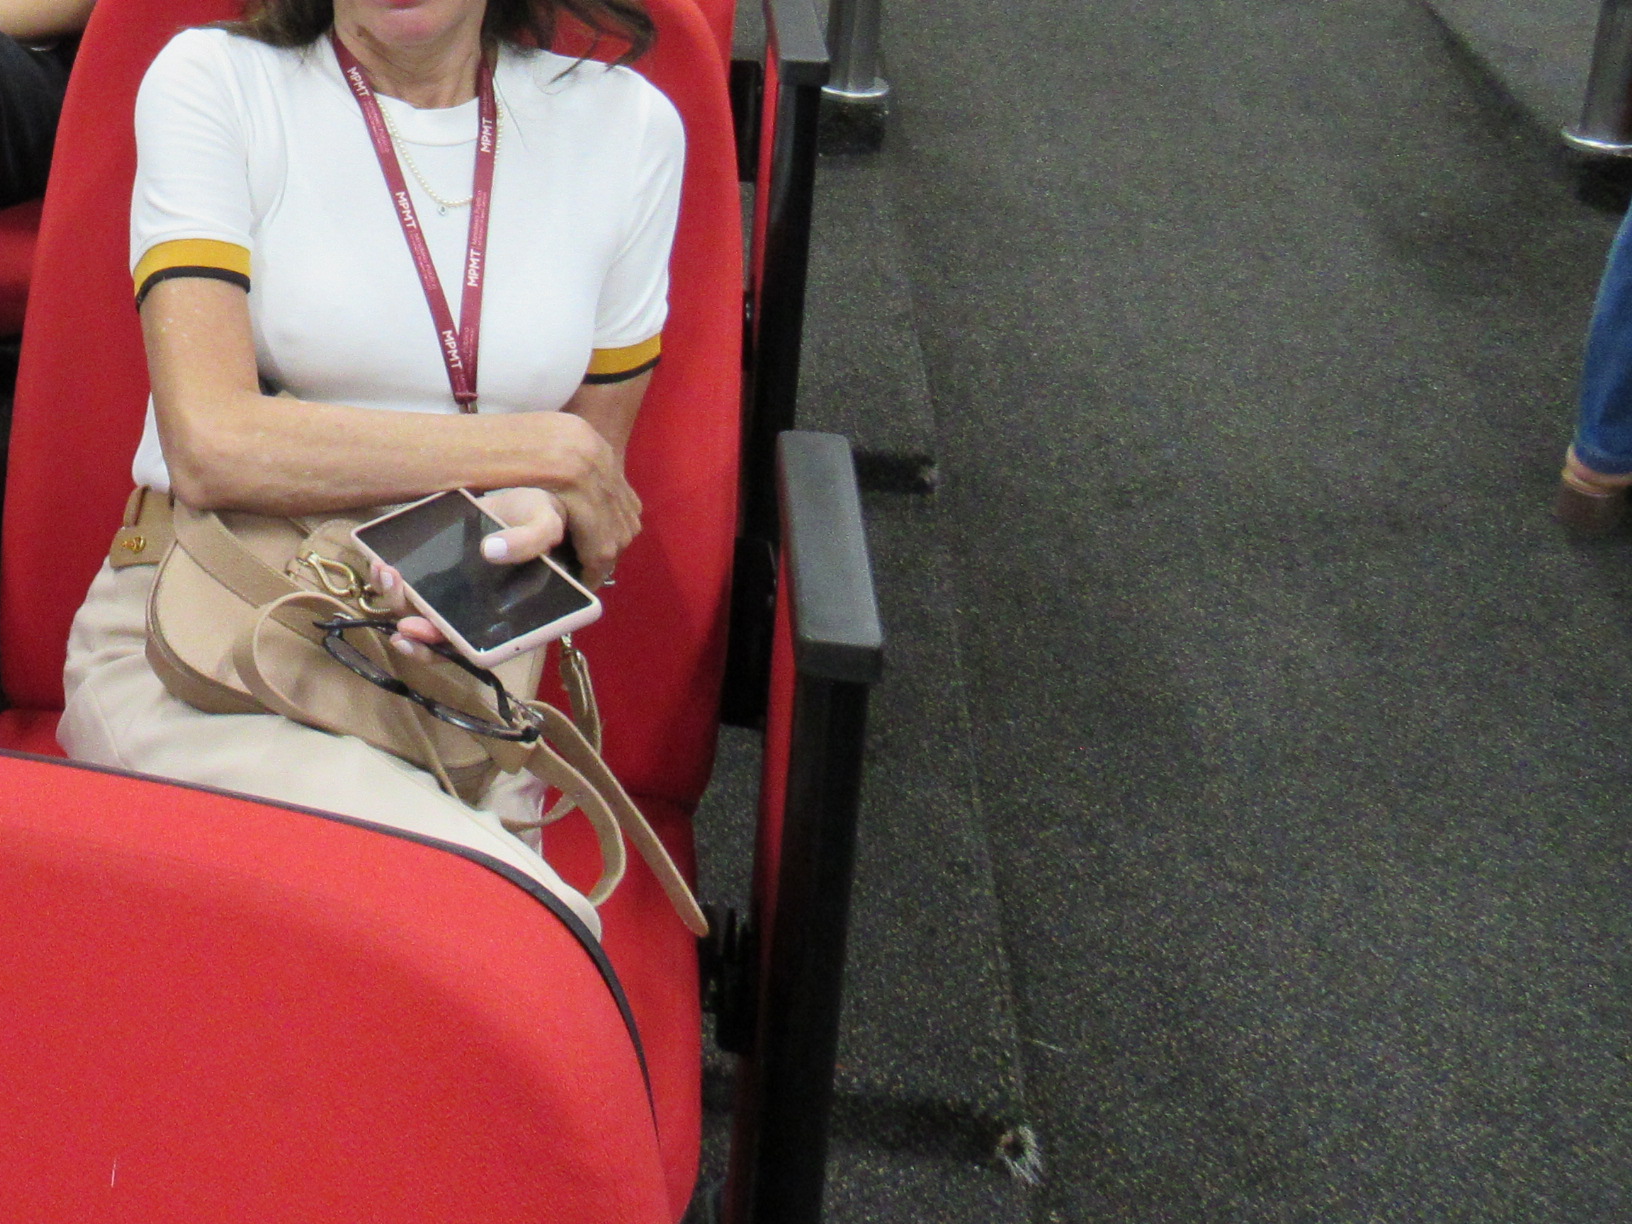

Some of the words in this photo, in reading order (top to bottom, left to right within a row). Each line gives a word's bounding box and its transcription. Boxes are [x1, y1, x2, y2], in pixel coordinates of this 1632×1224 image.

[347, 66, 370, 97] MPMT
[480, 116, 493, 153] MPMT
[395, 191, 417, 229] MPMT
[467, 248, 482, 287] MPMT
[442, 329, 463, 370] MPMT
